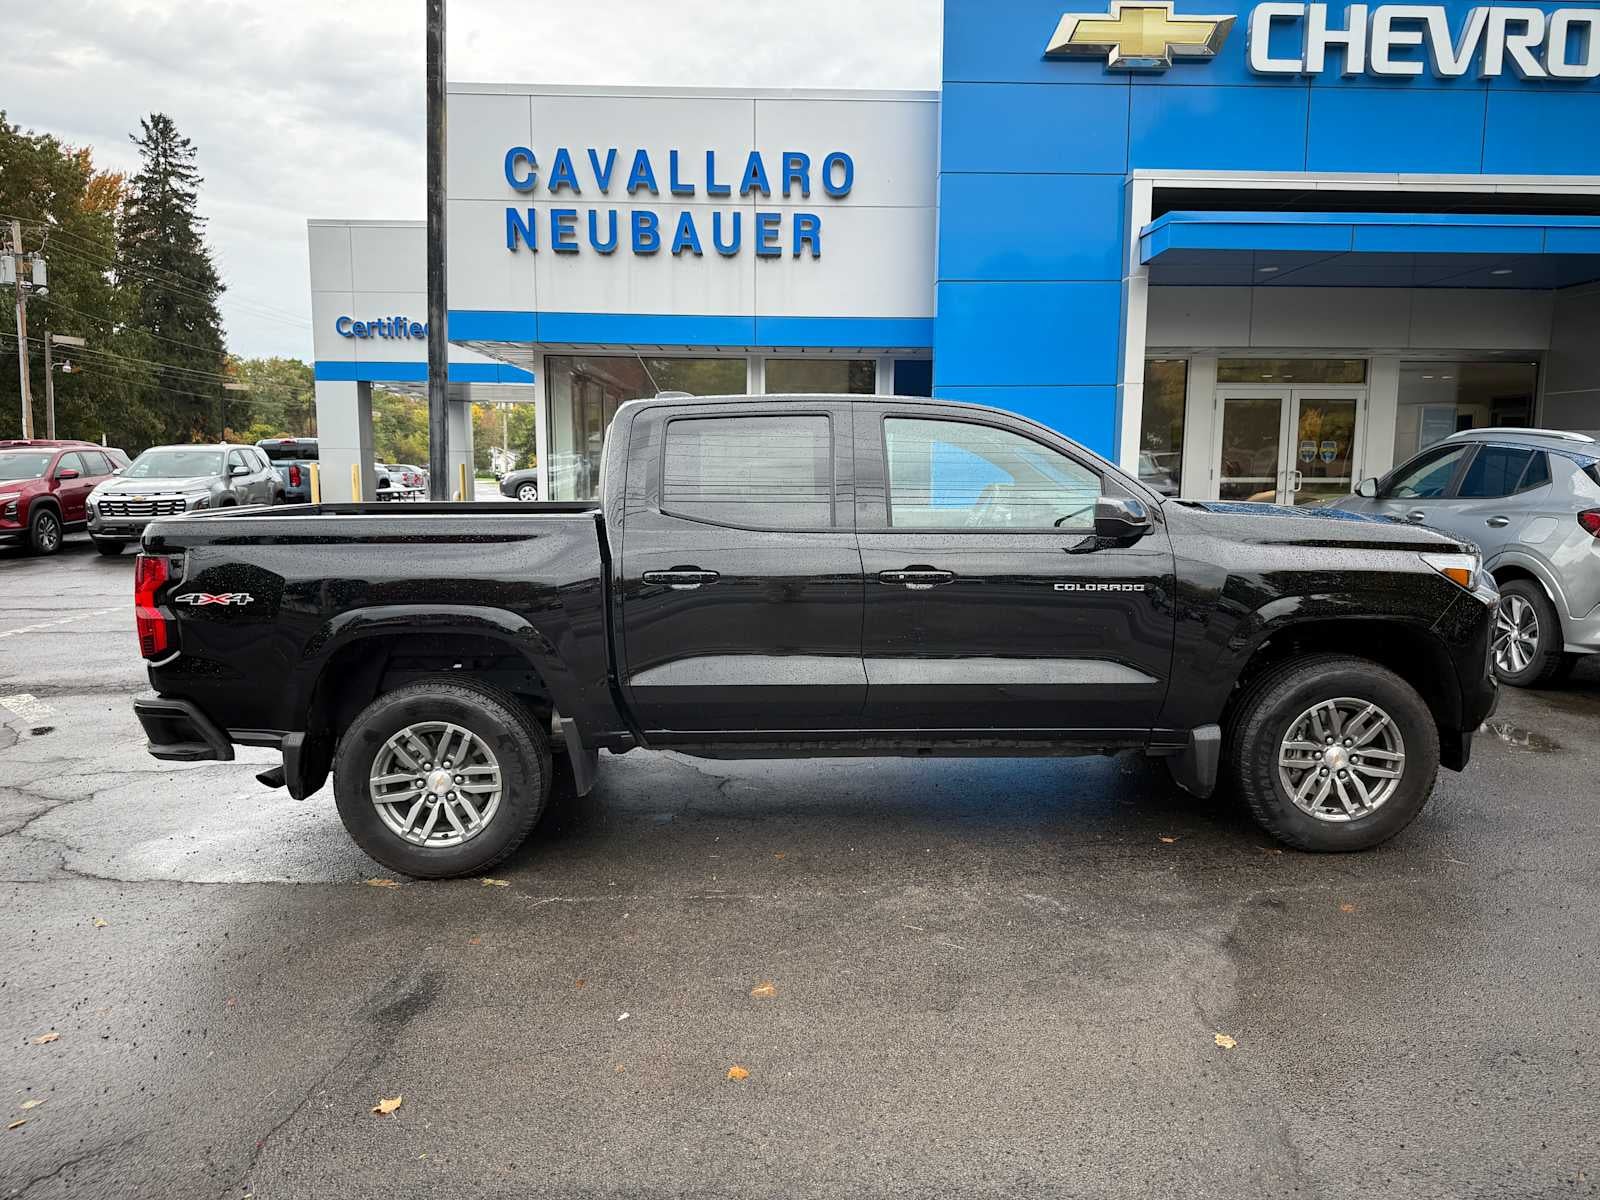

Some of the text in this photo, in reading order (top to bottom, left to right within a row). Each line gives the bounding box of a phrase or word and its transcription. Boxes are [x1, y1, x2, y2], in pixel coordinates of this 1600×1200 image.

[1249, 2, 1600, 78] CHEVRO
[504, 146, 855, 197] CAVALLARO
[505, 207, 822, 257] NEUBAUER
[336, 316, 429, 338] Certifie
[1053, 583, 1145, 592] COLORADO
